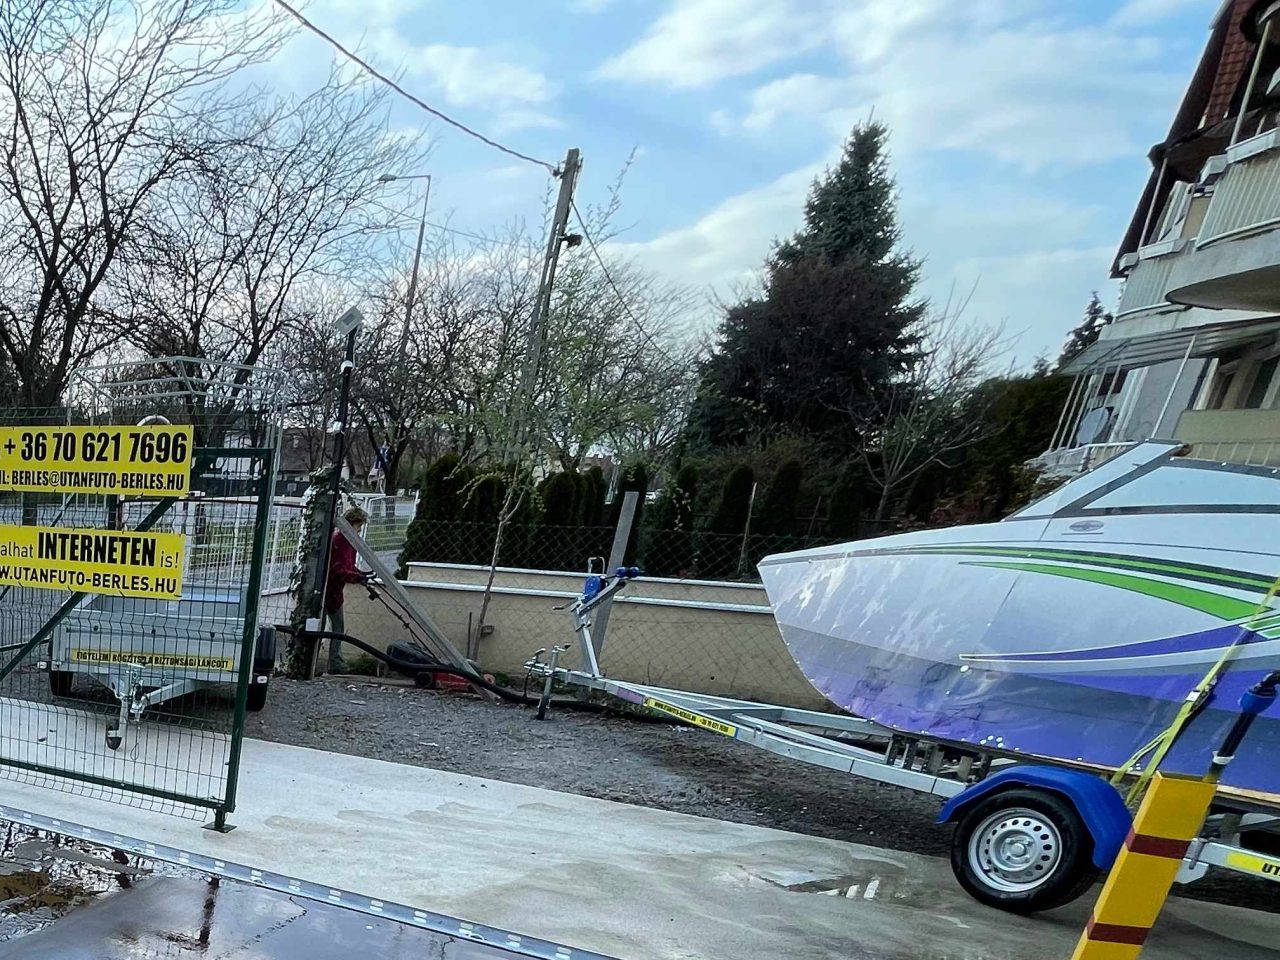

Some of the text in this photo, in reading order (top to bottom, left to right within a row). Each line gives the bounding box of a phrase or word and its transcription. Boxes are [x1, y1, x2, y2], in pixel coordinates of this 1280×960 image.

[21, 432, 47, 461] 36
[53, 432, 77, 461] 70
[82, 432, 121, 462] 621
[128, 432, 188, 464] 7696
[12, 470, 185, 491] BERLES@UTANFUTO-BERLES.HU
[38, 532, 157, 567] INTERNETEN
[160, 551, 179, 569] is!
